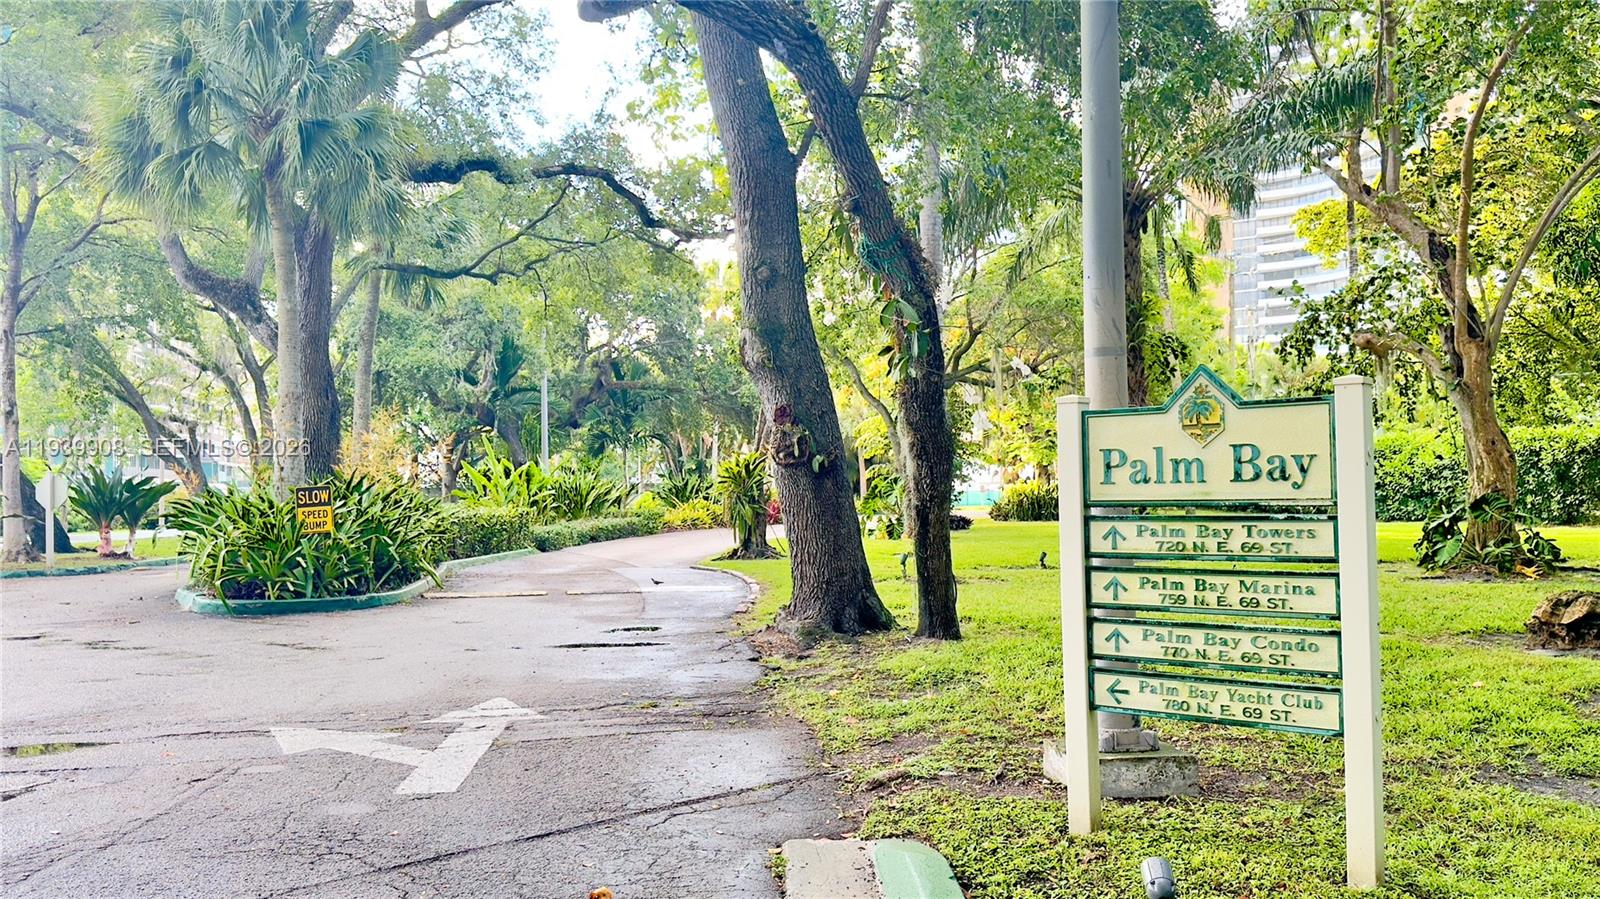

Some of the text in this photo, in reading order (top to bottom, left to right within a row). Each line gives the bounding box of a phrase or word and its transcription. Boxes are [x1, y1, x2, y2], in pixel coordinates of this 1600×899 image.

[1099, 443, 1317, 490] Palm Bay
[298, 490, 329, 505] SLOW
[302, 510, 328, 519] SPEED
[304, 521, 327, 531] BUMP
[1135, 524, 1317, 540] Palm Bay Towers
[1155, 541, 1299, 554] 720 N. E. 69 ST.
[1138, 576, 1317, 596] Palm Bay Marina
[1158, 593, 1294, 610] 759 N. E. 69 ST.
[1142, 628, 1320, 653] Palm Bay Condo
[1161, 645, 1295, 667] 770 N. E. 69 ST.
[1138, 680, 1324, 710] Palm Bay Yacht Club
[1162, 698, 1297, 723] 780 N. E. 69 ST.
